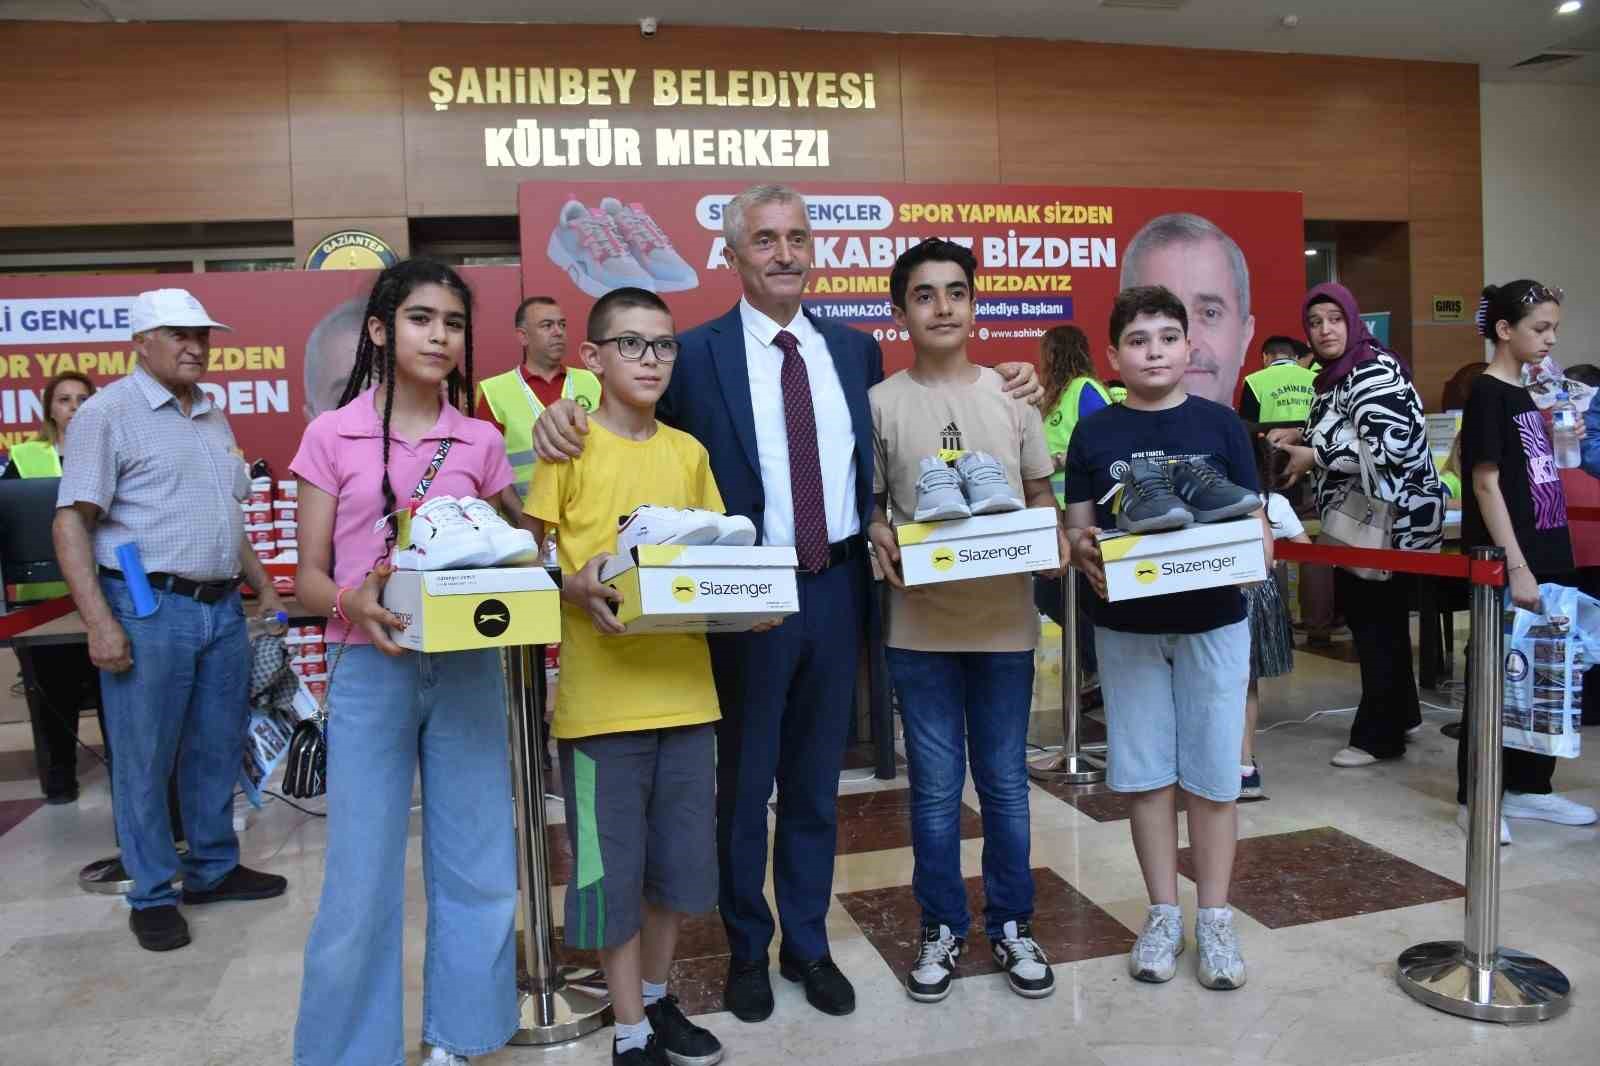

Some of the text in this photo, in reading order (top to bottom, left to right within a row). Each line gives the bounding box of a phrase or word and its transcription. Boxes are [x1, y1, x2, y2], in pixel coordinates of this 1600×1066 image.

[484, 119, 643, 167] KÜLTÜR
[807, 204, 881, 224] ENÇLER
[899, 201, 1113, 224] SPOR YAPMAK SİZDEN
[983, 230, 1117, 268] BİZDEN
[824, 302, 892, 317] TAHMAZOĞ
[1021, 303, 1063, 317] Başkanı
[20, 308, 130, 333] GENÇLE
[958, 544, 1033, 563] Slazenger
[1161, 556, 1237, 576] Slazenger
[699, 581, 773, 598] Slazenger
